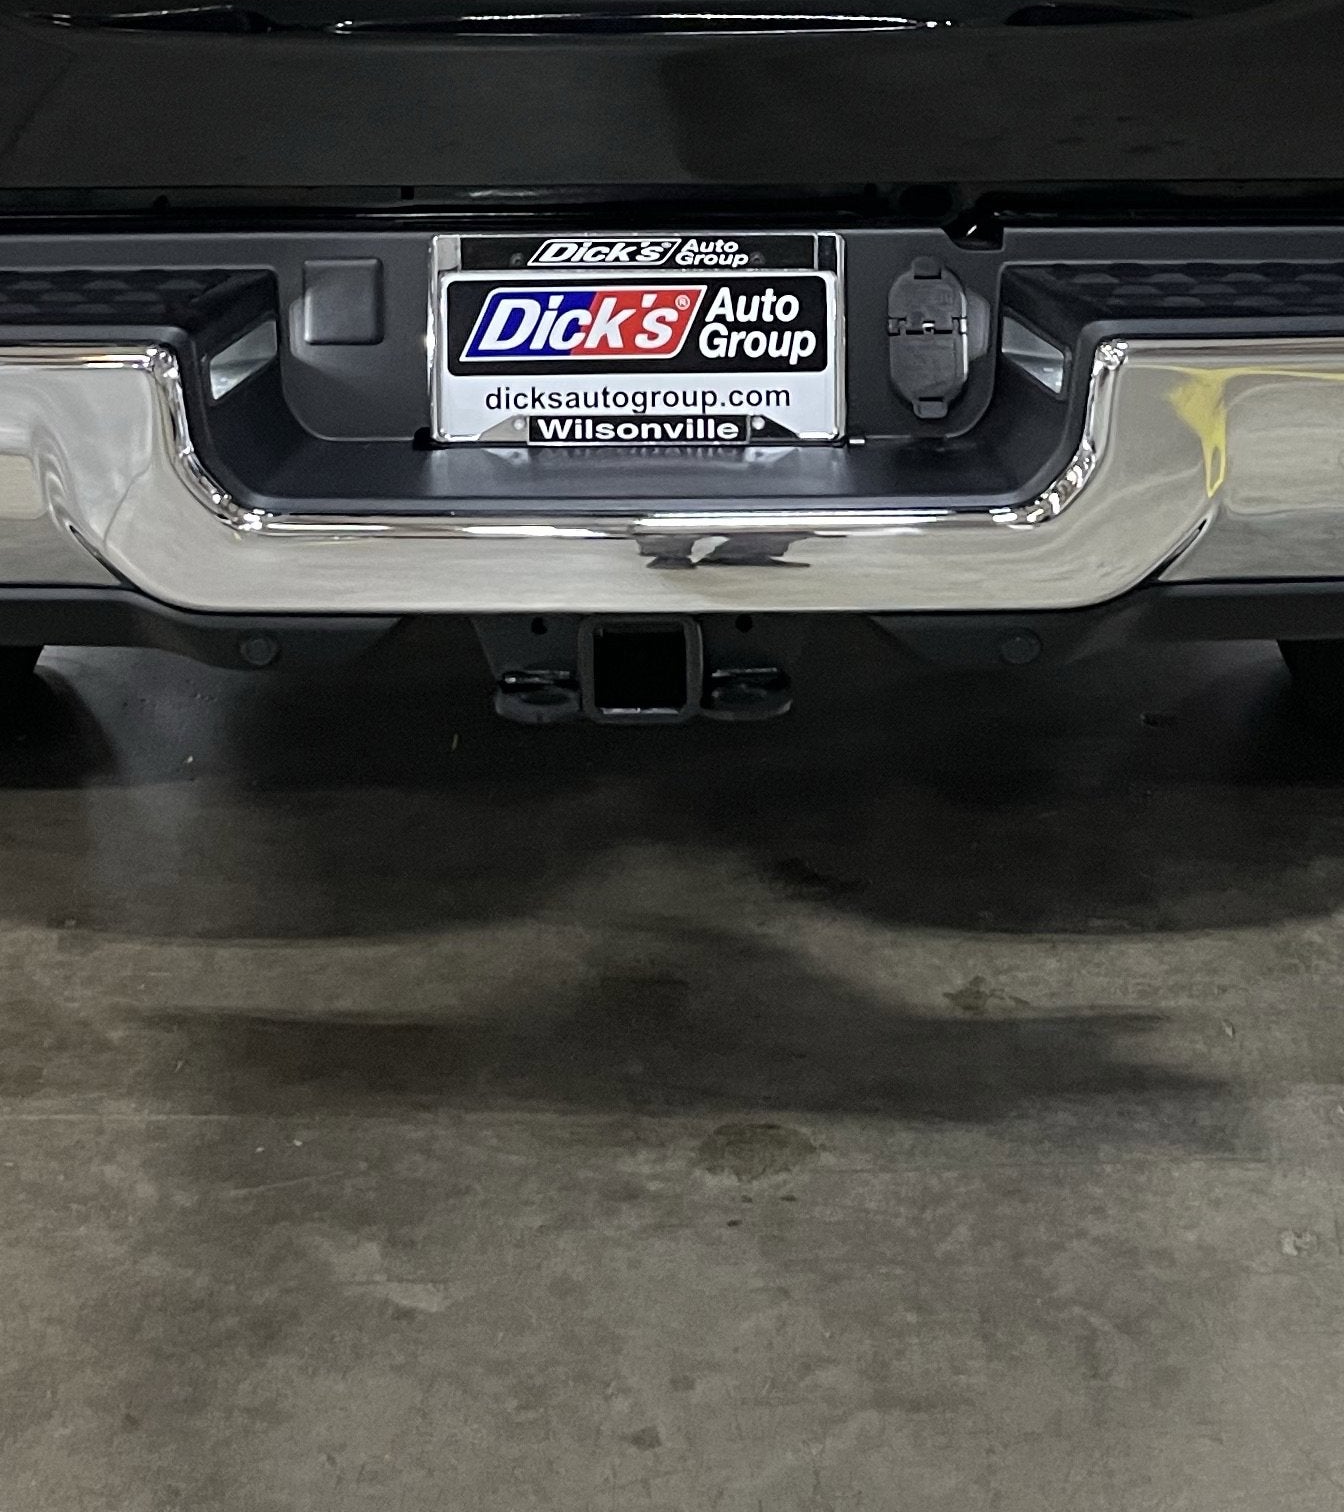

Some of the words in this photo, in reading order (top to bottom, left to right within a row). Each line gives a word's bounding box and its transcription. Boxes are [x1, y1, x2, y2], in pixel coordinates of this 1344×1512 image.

[684, 239, 739, 253] Auto
[675, 251, 749, 267] Group
[704, 286, 799, 323] Auto
[698, 323, 817, 365] Group
[485, 386, 791, 414] dicksautogroup.com
[537, 418, 740, 440] Wilsonville
